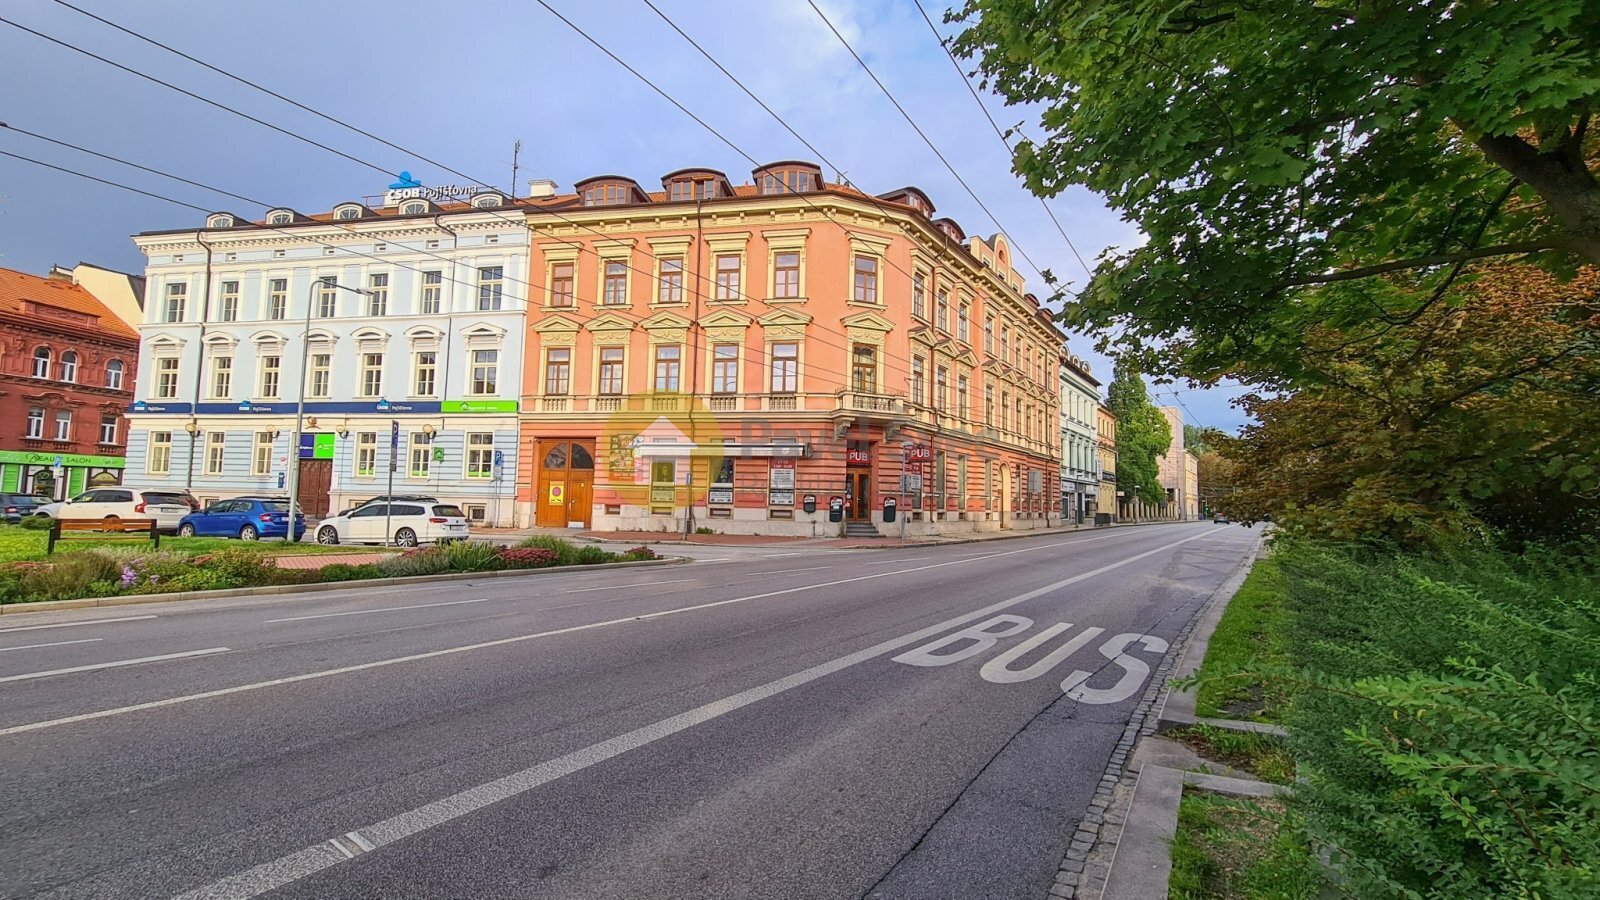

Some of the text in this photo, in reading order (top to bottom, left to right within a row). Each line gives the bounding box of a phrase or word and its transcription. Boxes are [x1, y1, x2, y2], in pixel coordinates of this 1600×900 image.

[849, 452, 868, 462] PUB
[911, 448, 930, 458] PUB
[65, 456, 91, 464] SALON
[890, 614, 1169, 705] BUS
